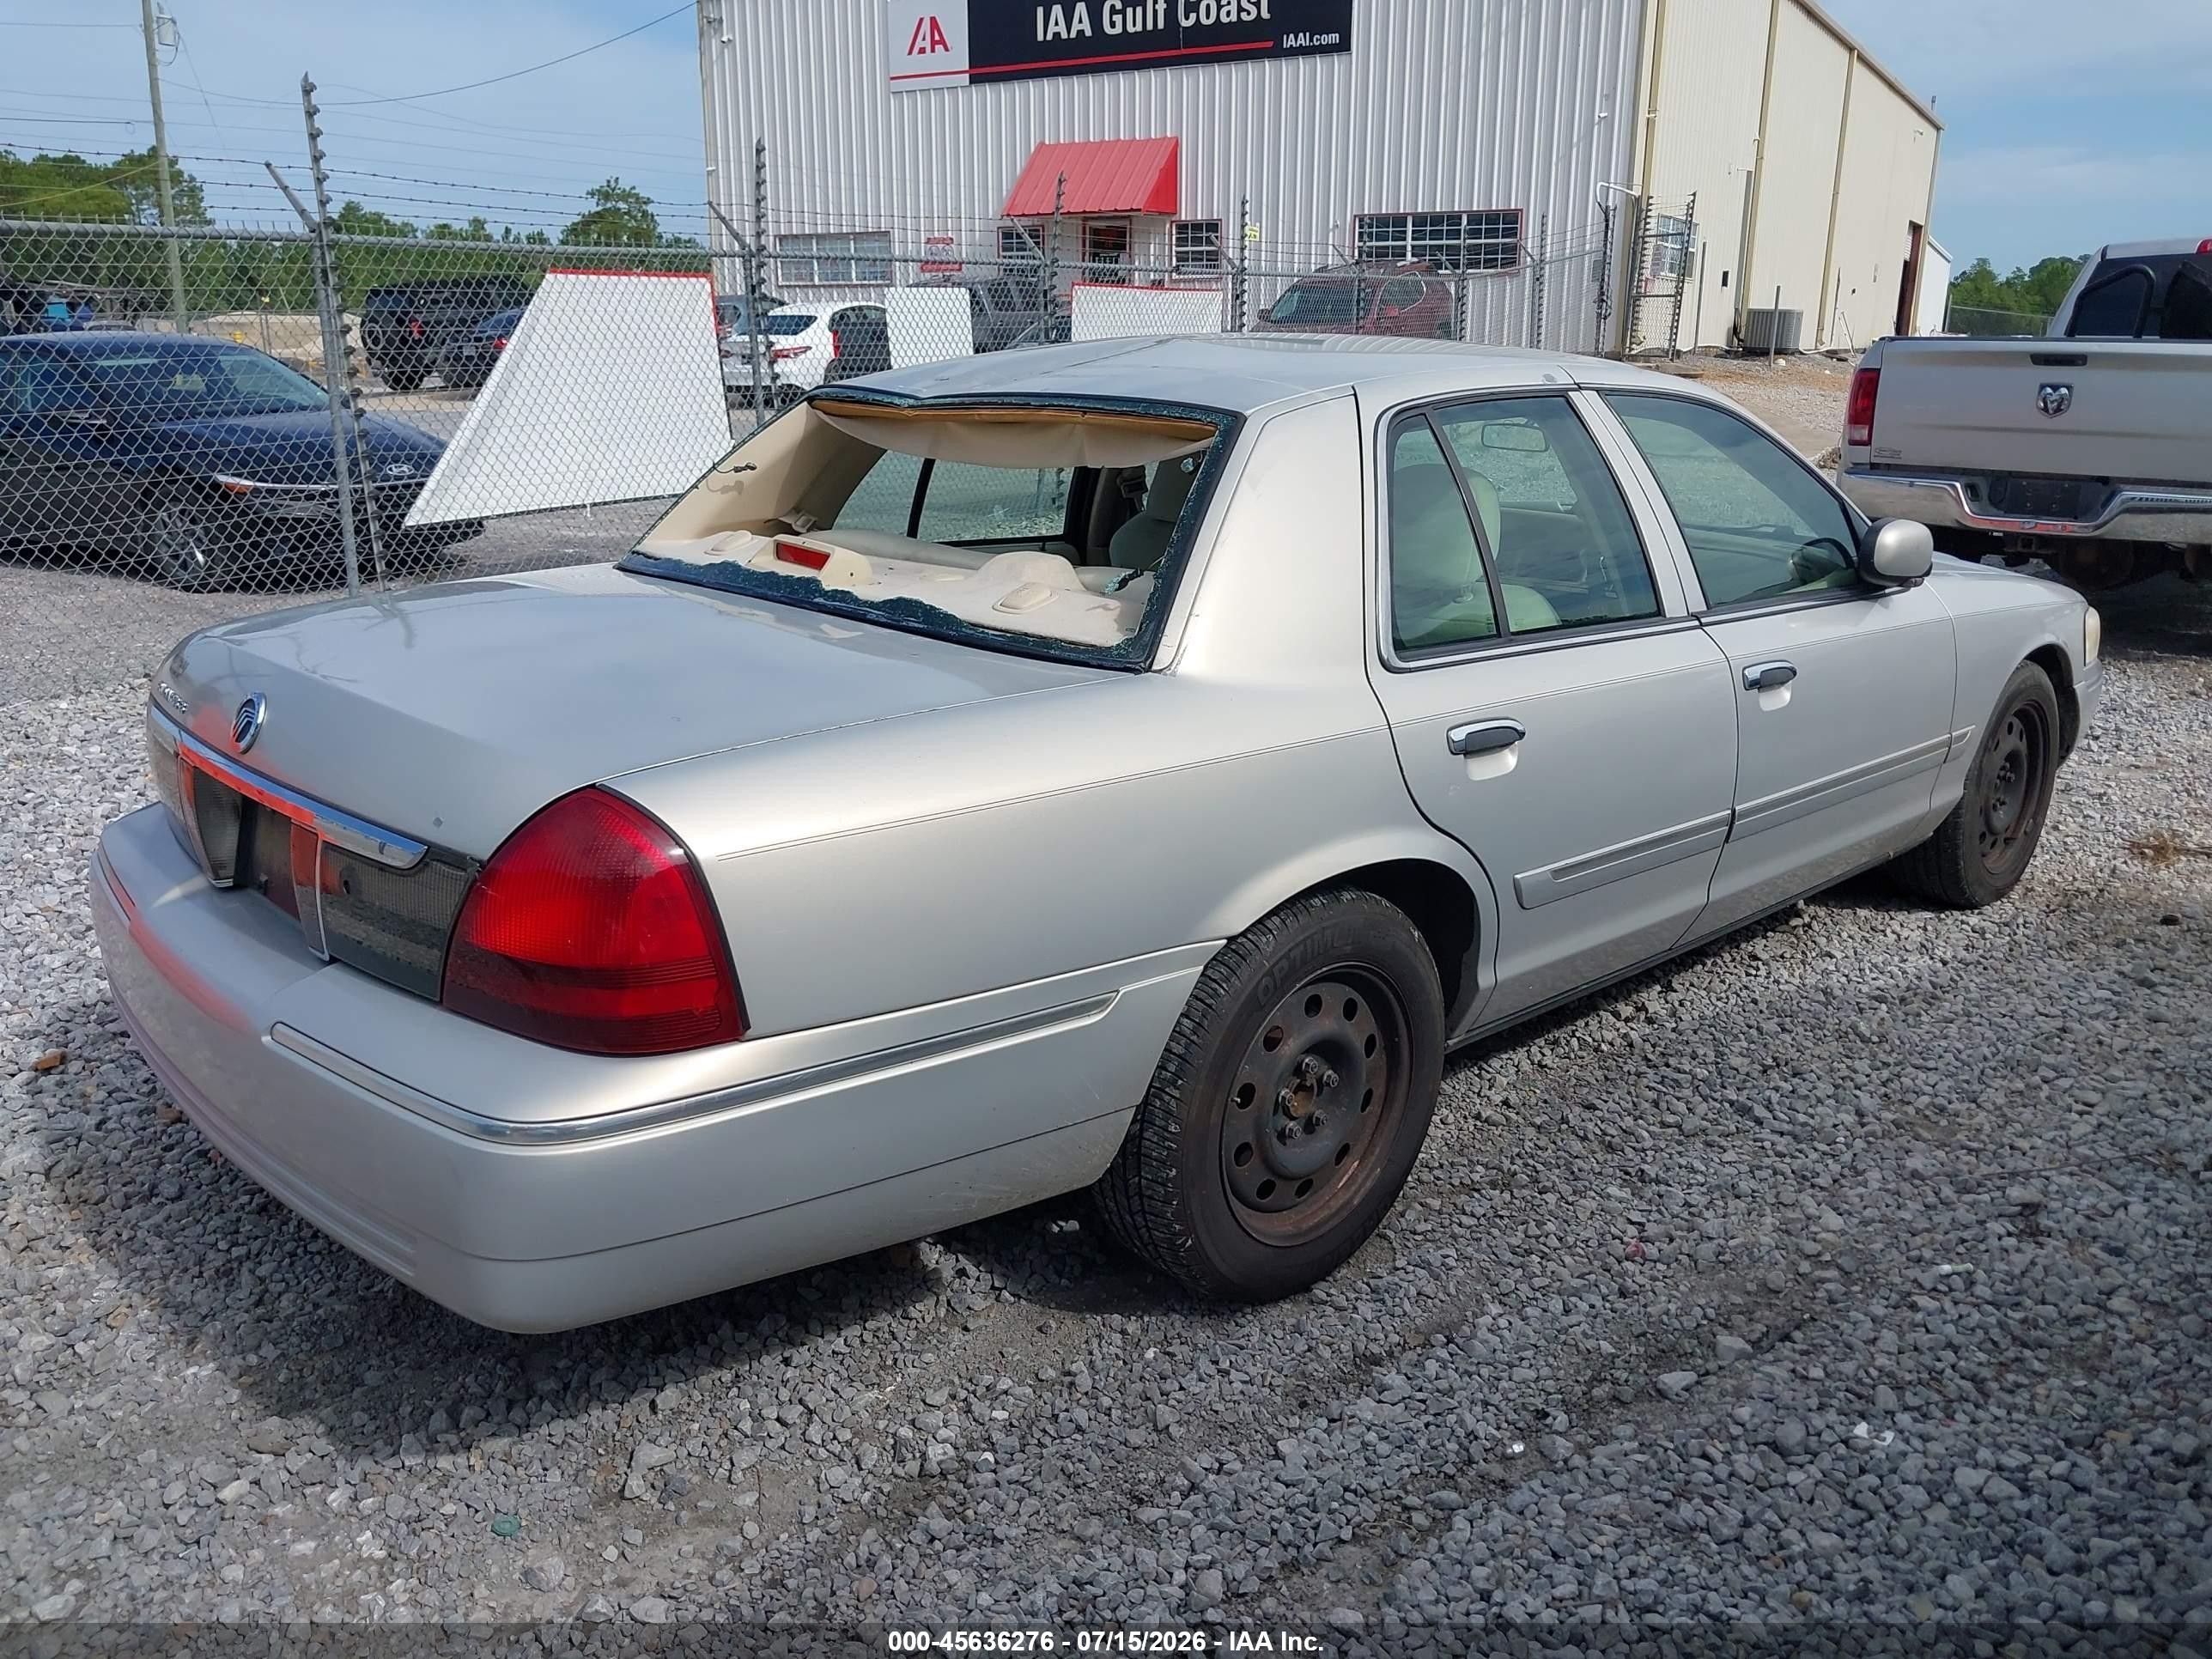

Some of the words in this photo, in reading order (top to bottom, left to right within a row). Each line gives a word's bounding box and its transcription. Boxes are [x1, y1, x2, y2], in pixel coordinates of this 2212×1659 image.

[1036, 2, 1092, 42] IAA
[1103, 0, 1167, 34] Gulf
[1178, 0, 1271, 27] Coast
[1283, 32, 1340, 49] IAAI.com
